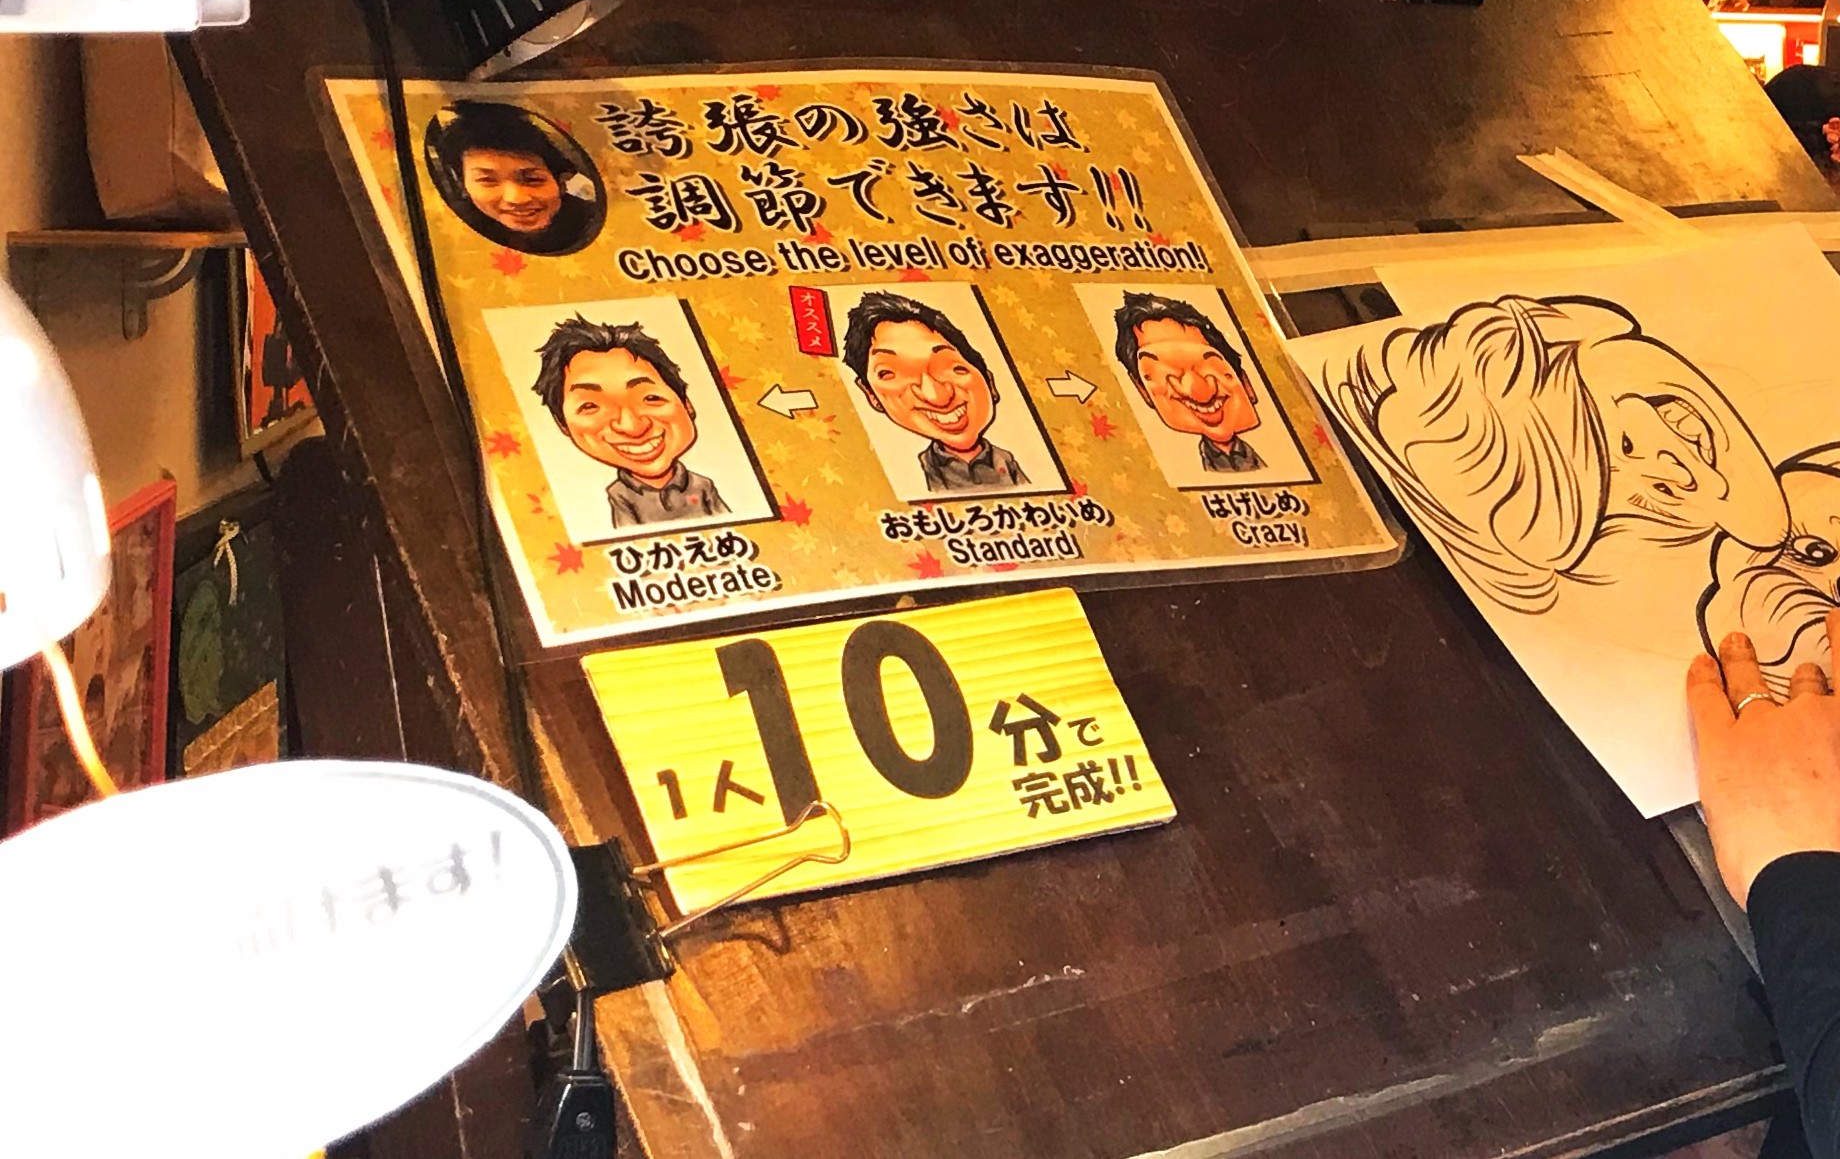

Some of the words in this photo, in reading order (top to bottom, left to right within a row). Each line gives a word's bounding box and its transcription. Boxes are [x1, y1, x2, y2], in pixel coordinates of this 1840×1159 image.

[595, 92, 1081, 158] 誇張の強さは
[626, 158, 1147, 234] 調節できます!!
[619, 248, 772, 281] Choose
[784, 238, 843, 272] the
[853, 237, 941, 271] level
[951, 235, 985, 268] of
[998, 237, 1206, 274] exaggeration!
[798, 290, 825, 350] オススメ
[880, 494, 1112, 542] おもしろかわいめ
[1204, 492, 1306, 519] はげしめ
[610, 530, 752, 577] ひかえめ
[947, 530, 1079, 566] Standard
[1234, 519, 1304, 548] Crazy
[611, 564, 776, 612] Moderate
[1011, 753, 1145, 821] 完成!!
